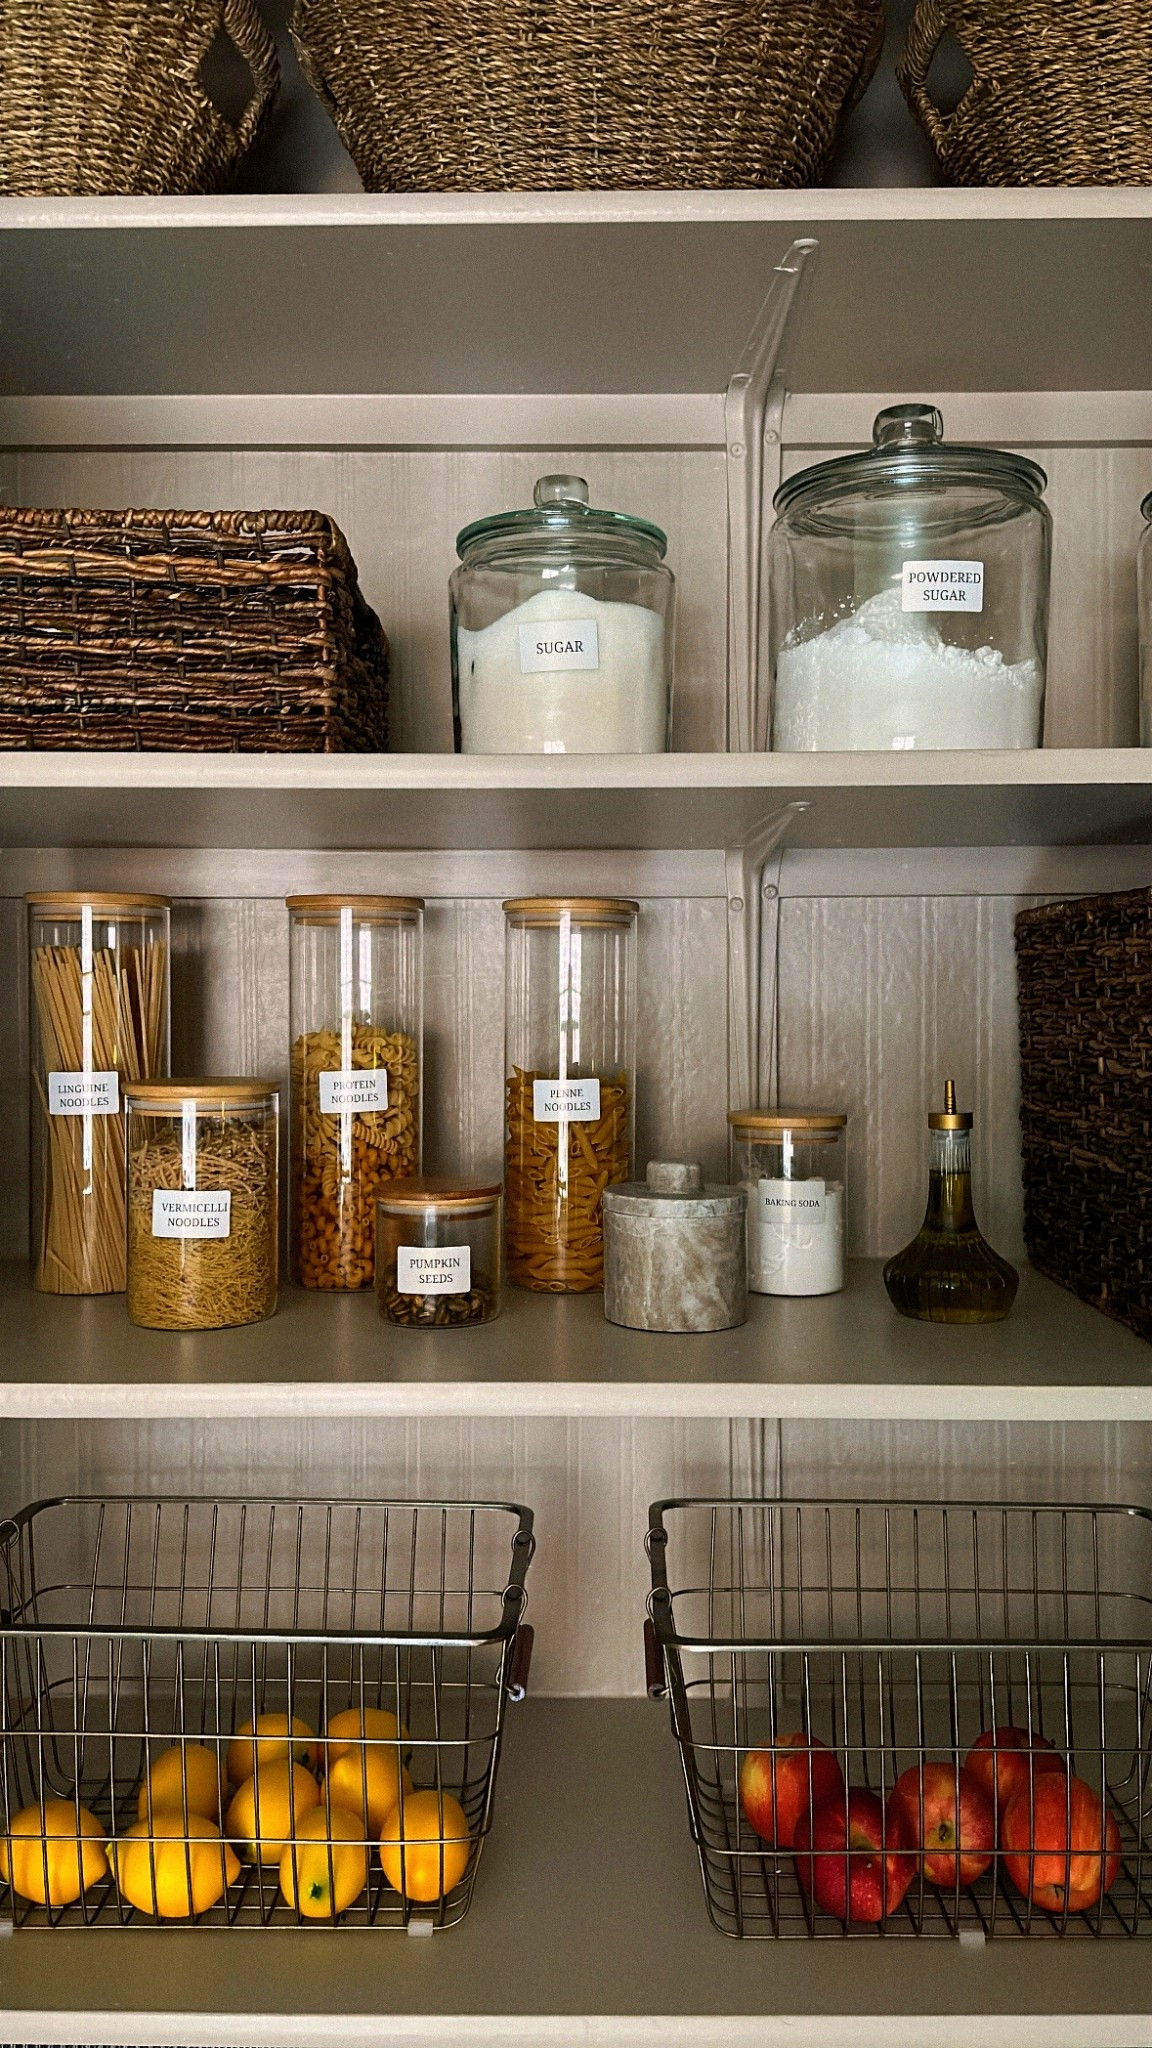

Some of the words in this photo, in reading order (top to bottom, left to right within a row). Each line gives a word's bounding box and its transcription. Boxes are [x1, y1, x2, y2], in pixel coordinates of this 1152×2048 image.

[909, 571, 981, 584] POWDERED
[922, 589, 967, 601] SUGAR
[536, 640, 584, 655] SUGAR
[58, 1083, 109, 1094] LINGUINE
[333, 1080, 376, 1090] PROTEIN
[331, 1093, 379, 1104] NOODLES
[549, 1089, 584, 1098] PENNE
[59, 1097, 110, 1107] NOODLES
[544, 1101, 591, 1112] NOODLES
[161, 1203, 228, 1213] VERMICELLI
[765, 1197, 797, 1208] BAKING
[798, 1199, 820, 1208] SODA
[167, 1217, 220, 1228] NOODLES
[409, 1258, 461, 1269] PUMPKIN
[419, 1274, 454, 1284] SEEDS
